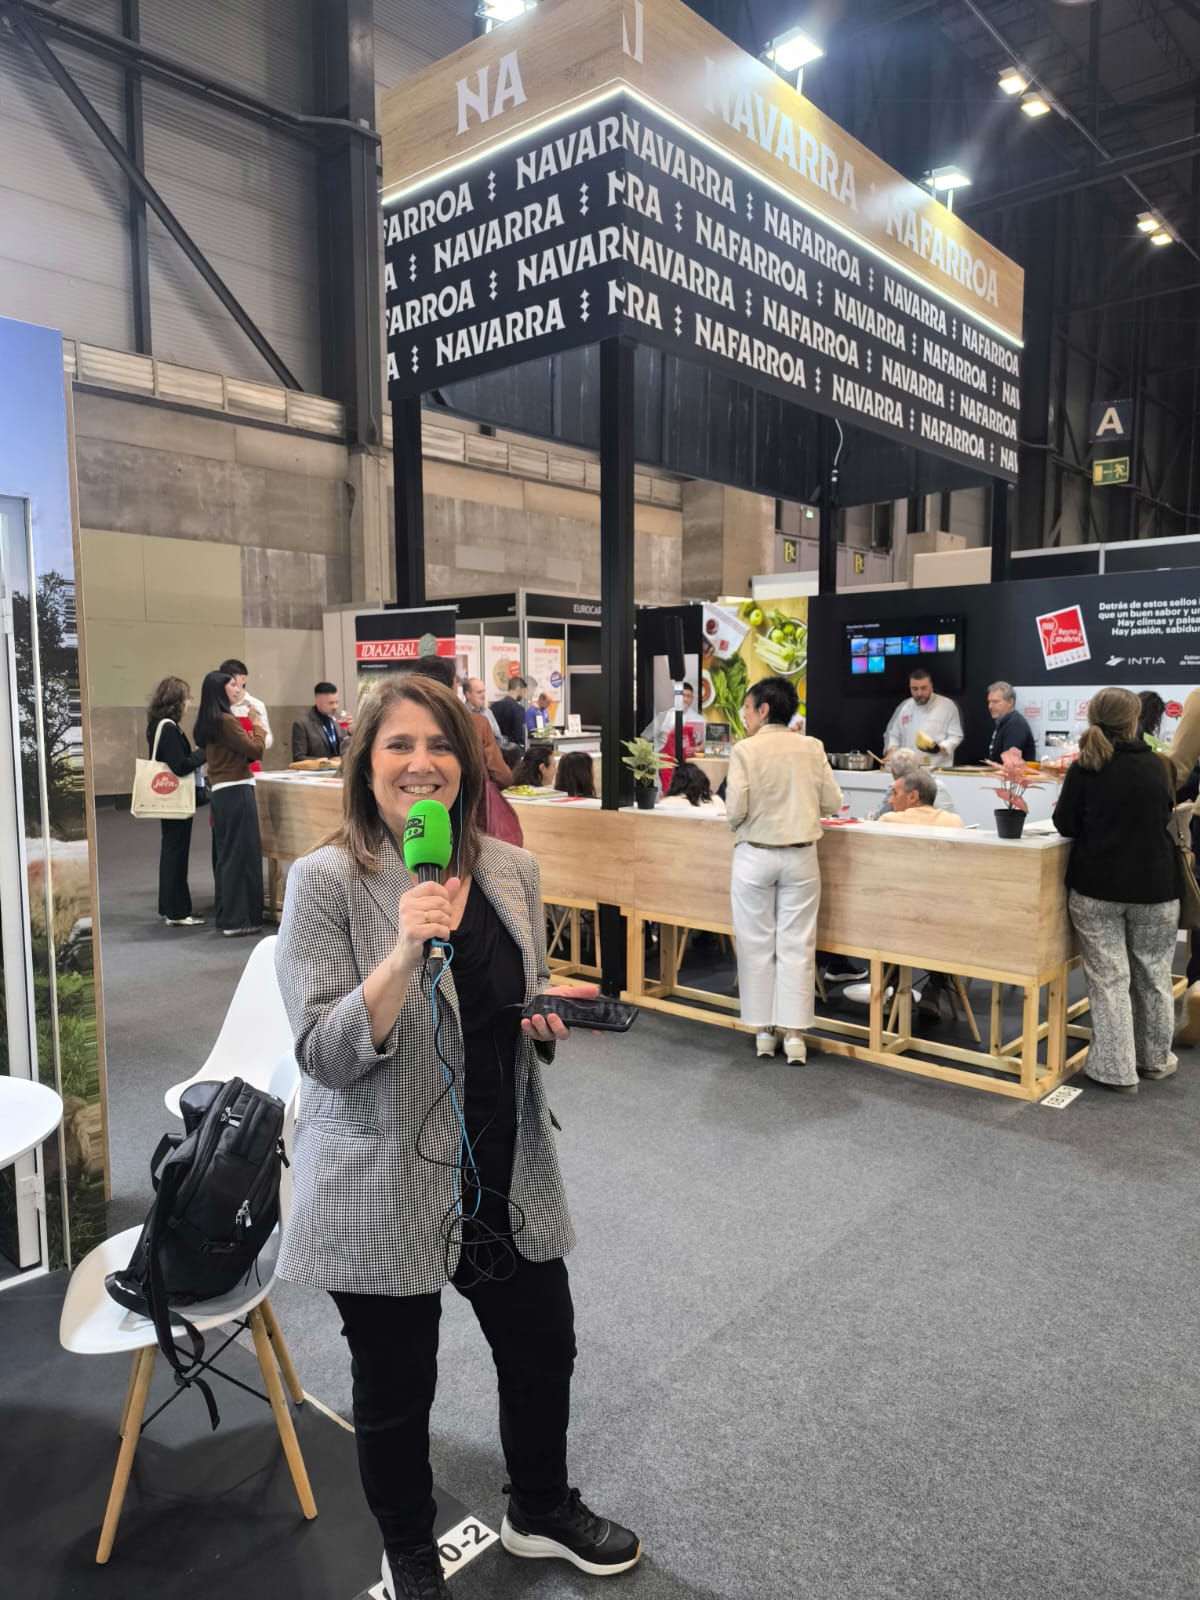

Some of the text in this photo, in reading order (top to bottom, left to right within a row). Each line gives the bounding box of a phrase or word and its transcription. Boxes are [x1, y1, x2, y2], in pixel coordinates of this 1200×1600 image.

[456, 51, 527, 135] NA
[704, 56, 998, 307] NAVARRA NAFARROA
[434, 194, 565, 274] NAVARRA
[621, 112, 1020, 377] NAVARRA NAFARROA NAVARRA NAFARROA
[436, 298, 566, 367] NAVARRA
[621, 223, 1017, 440] NAVARRA NAFARROA NAVARRA NAFARROA
[696, 211, 808, 300] NAFARROA
[834, 288, 906, 351] NAVARRA
[923, 338, 988, 394] NAFARROA
[695, 313, 806, 389] NAFARROA
[832, 373, 904, 428] NAVARRA
[920, 412, 985, 460] NAFARROA
[1096, 407, 1124, 437] A
[1098, 612, 1115, 620] que
[1130, 610, 1153, 618] buen
[1155, 608, 1180, 616] sabor
[1099, 601, 1128, 610] Detrás
[1129, 600, 1141, 609] de
[1143, 600, 1168, 608] estos
[1169, 597, 1197, 606] sellos
[1112, 627, 1129, 636] Hay
[1130, 627, 1163, 636] pasión,
[1117, 619, 1135, 627] Hay
[1136, 618, 1166, 626] climas
[1168, 618, 1174, 626] y
[361, 643, 417, 657] IDIAZABAL
[1128, 657, 1166, 665] INTIA
